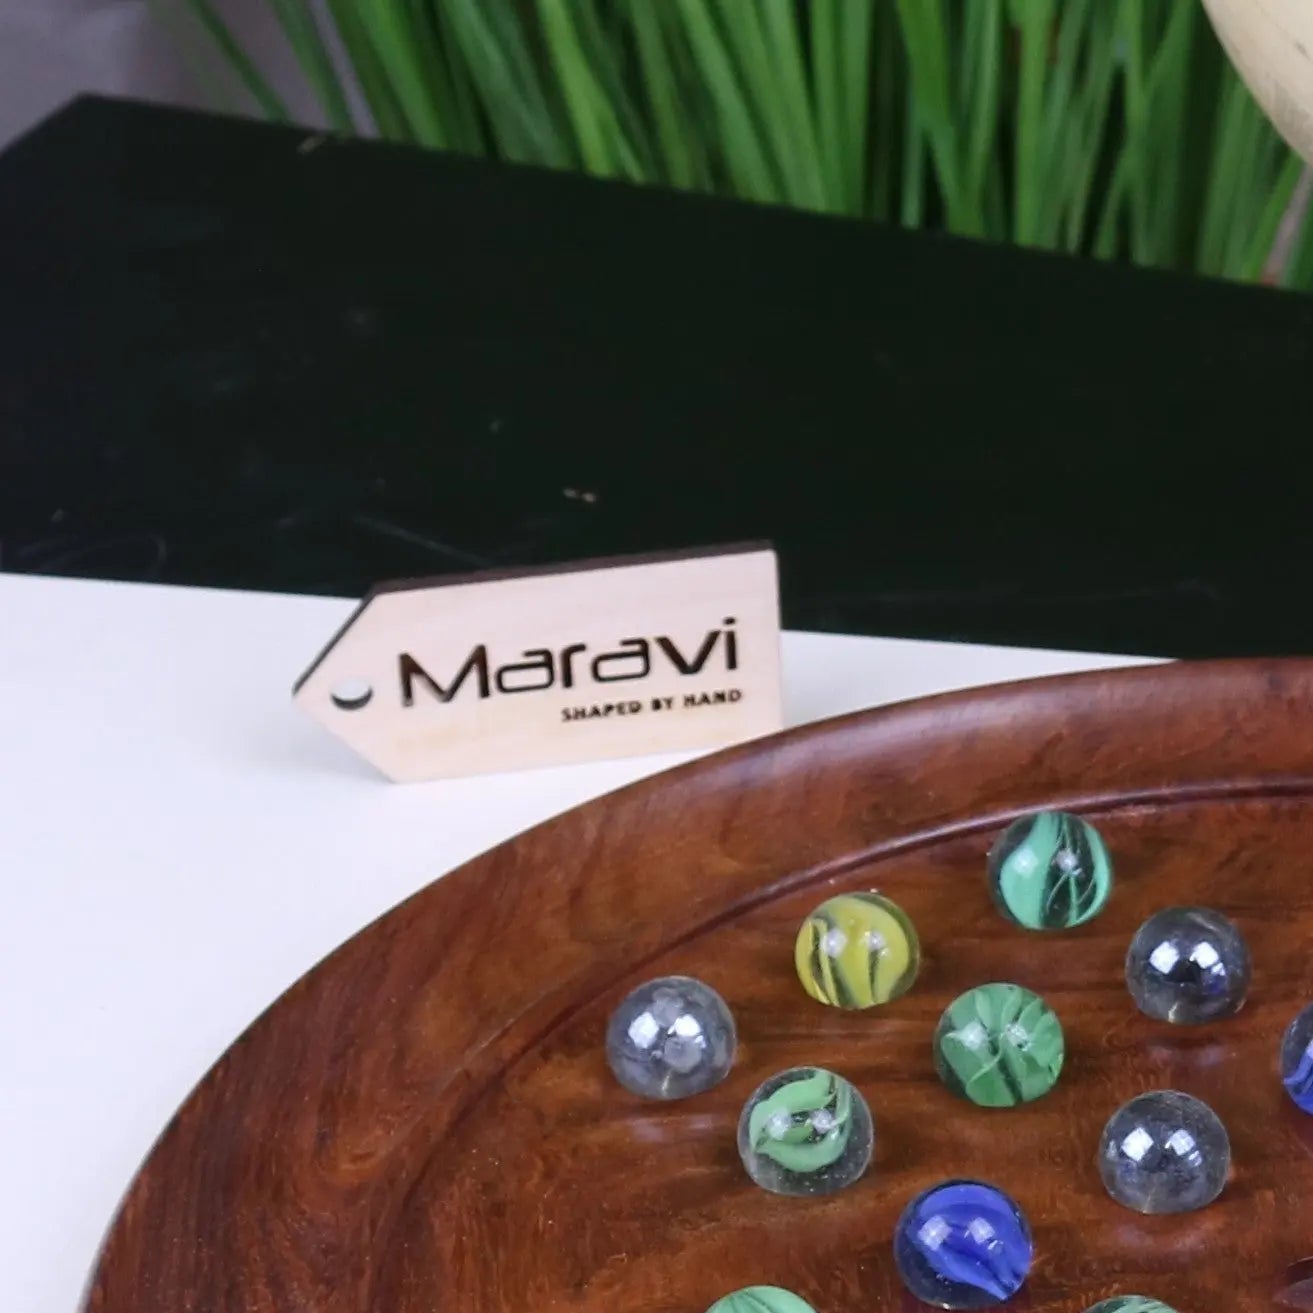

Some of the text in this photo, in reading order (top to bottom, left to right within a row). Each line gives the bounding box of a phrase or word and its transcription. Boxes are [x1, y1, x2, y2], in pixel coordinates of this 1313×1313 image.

[398, 616, 738, 708] Maravi
[561, 689, 742, 722] SHAPED BY HAND
